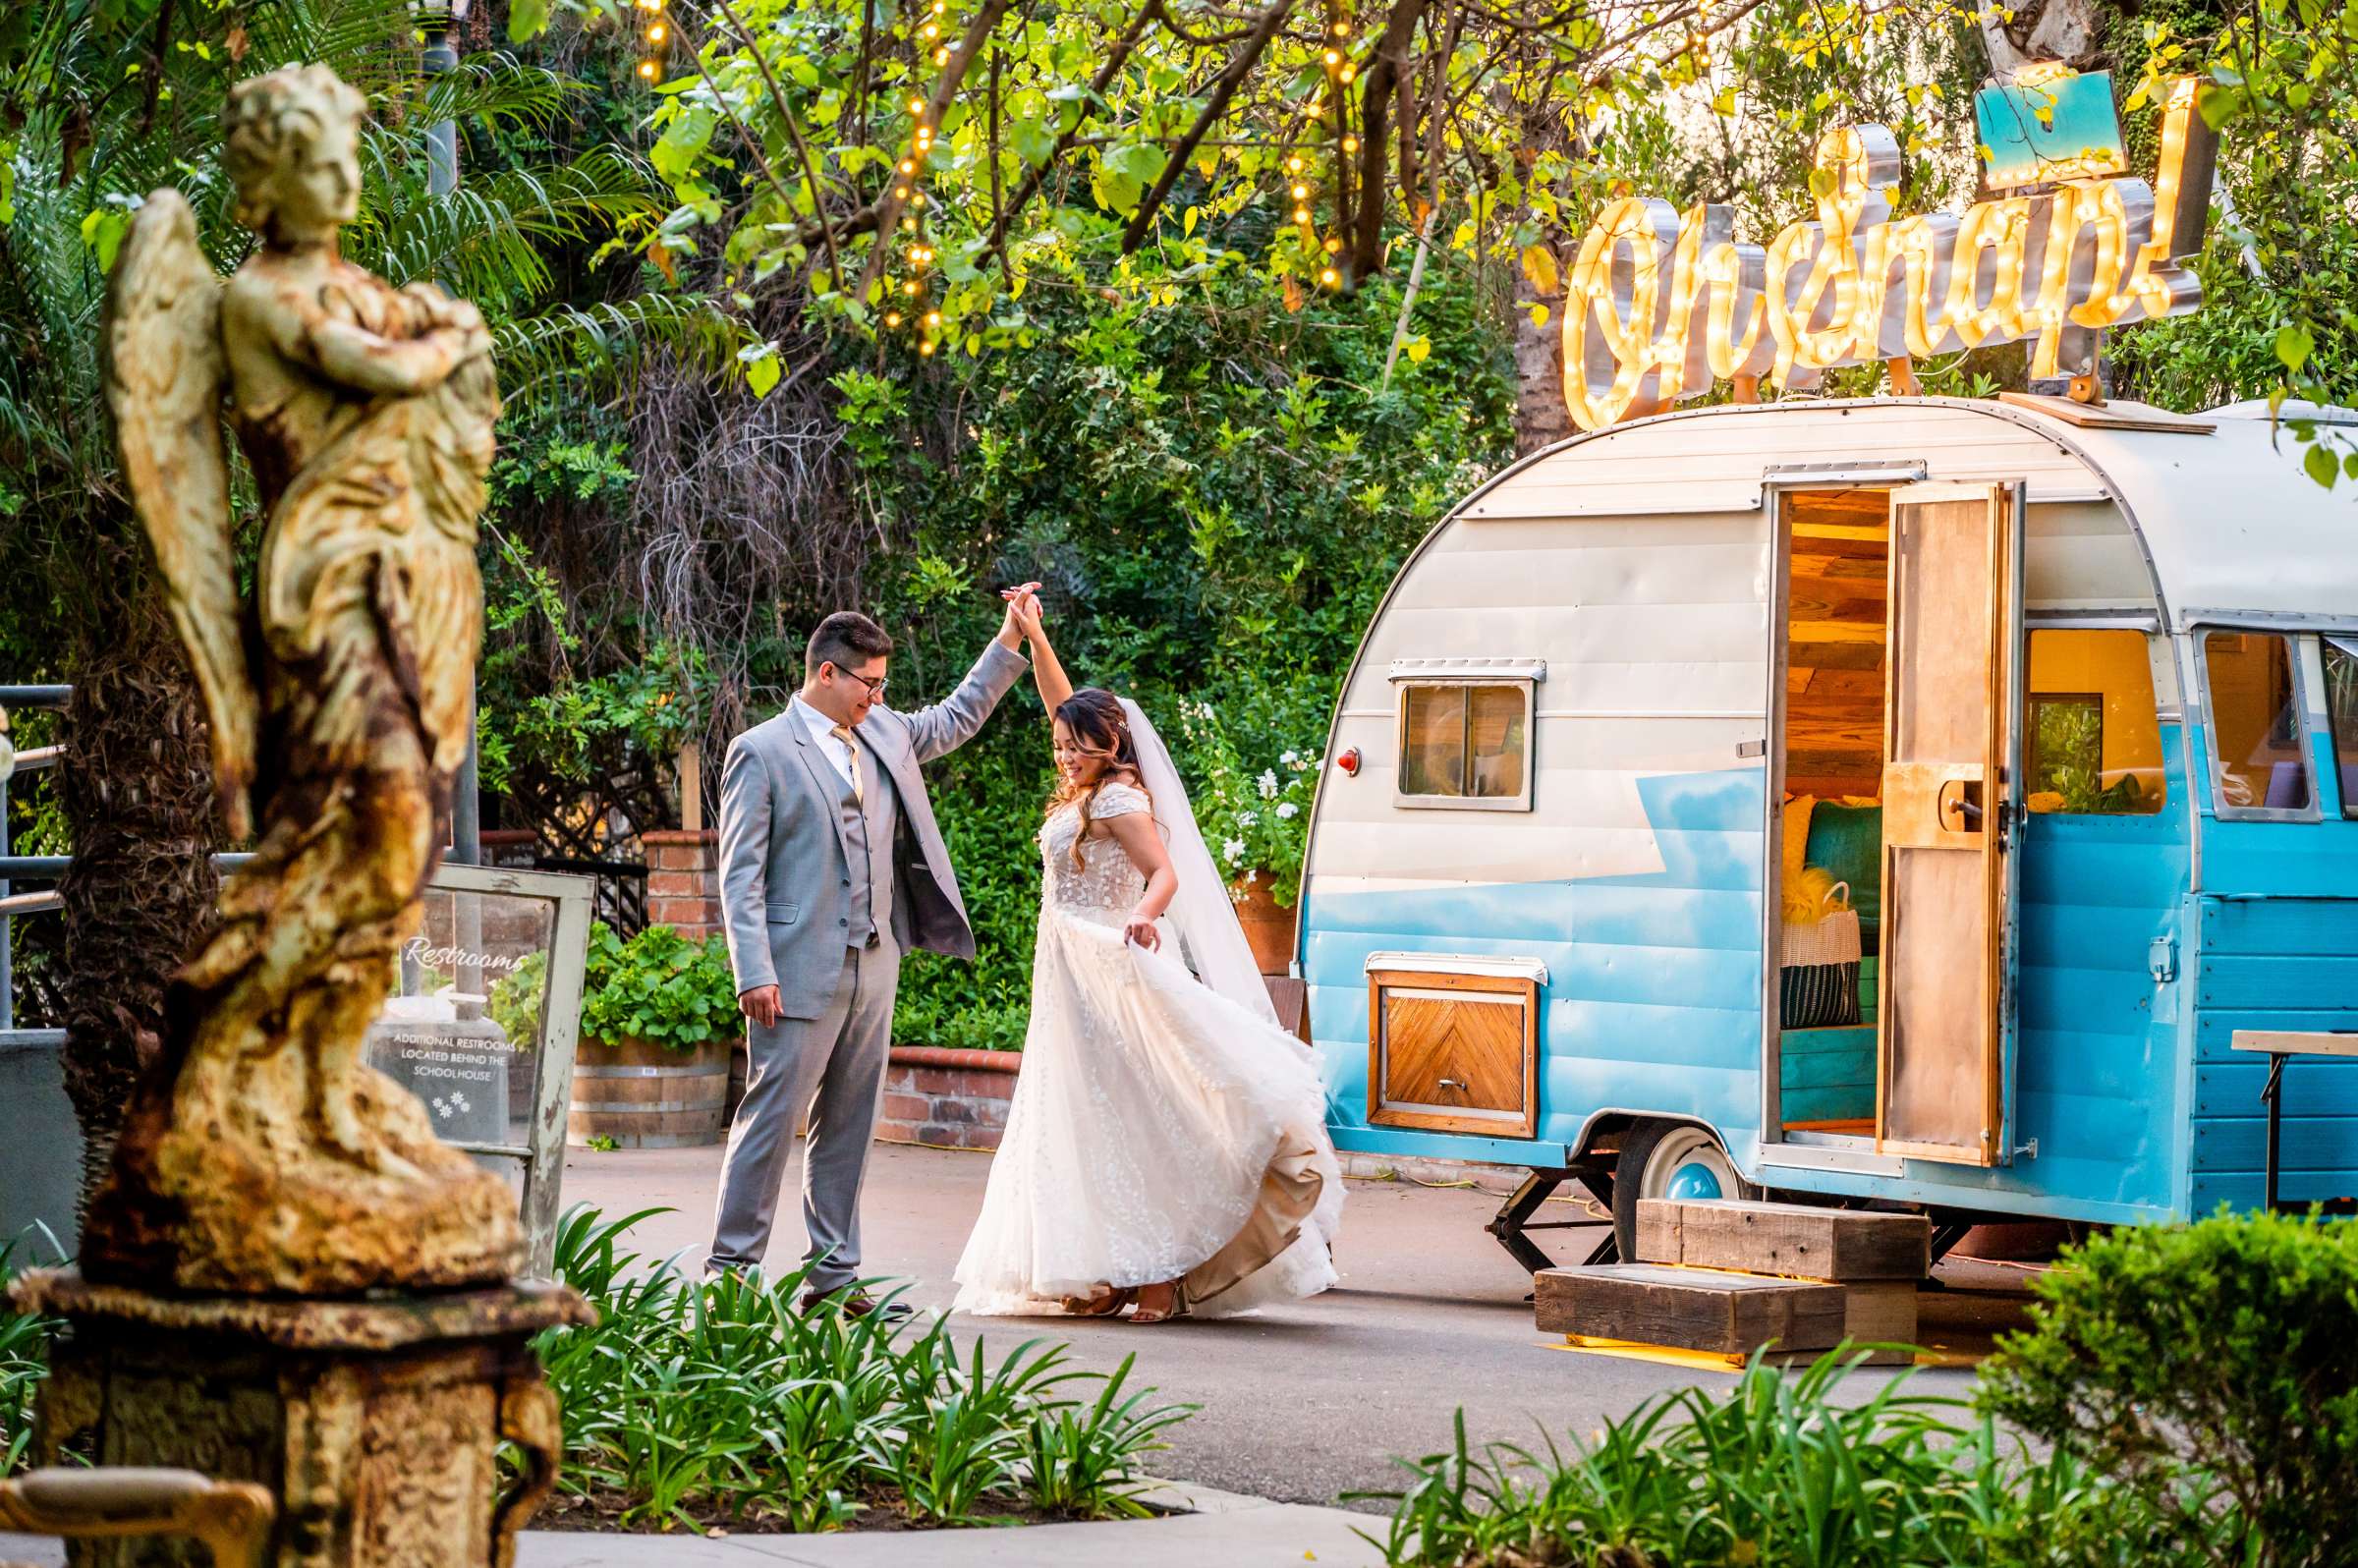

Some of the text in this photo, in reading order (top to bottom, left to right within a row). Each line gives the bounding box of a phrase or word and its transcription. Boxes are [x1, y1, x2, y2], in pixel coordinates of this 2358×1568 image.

[405, 937, 529, 972] Restrooms
[393, 1033, 516, 1052] ADDITIONAL RESTROOMS
[401, 1048, 507, 1066] LOCATED BEHIND THE
[414, 1066, 491, 1082] SCHOOLHOUSE
